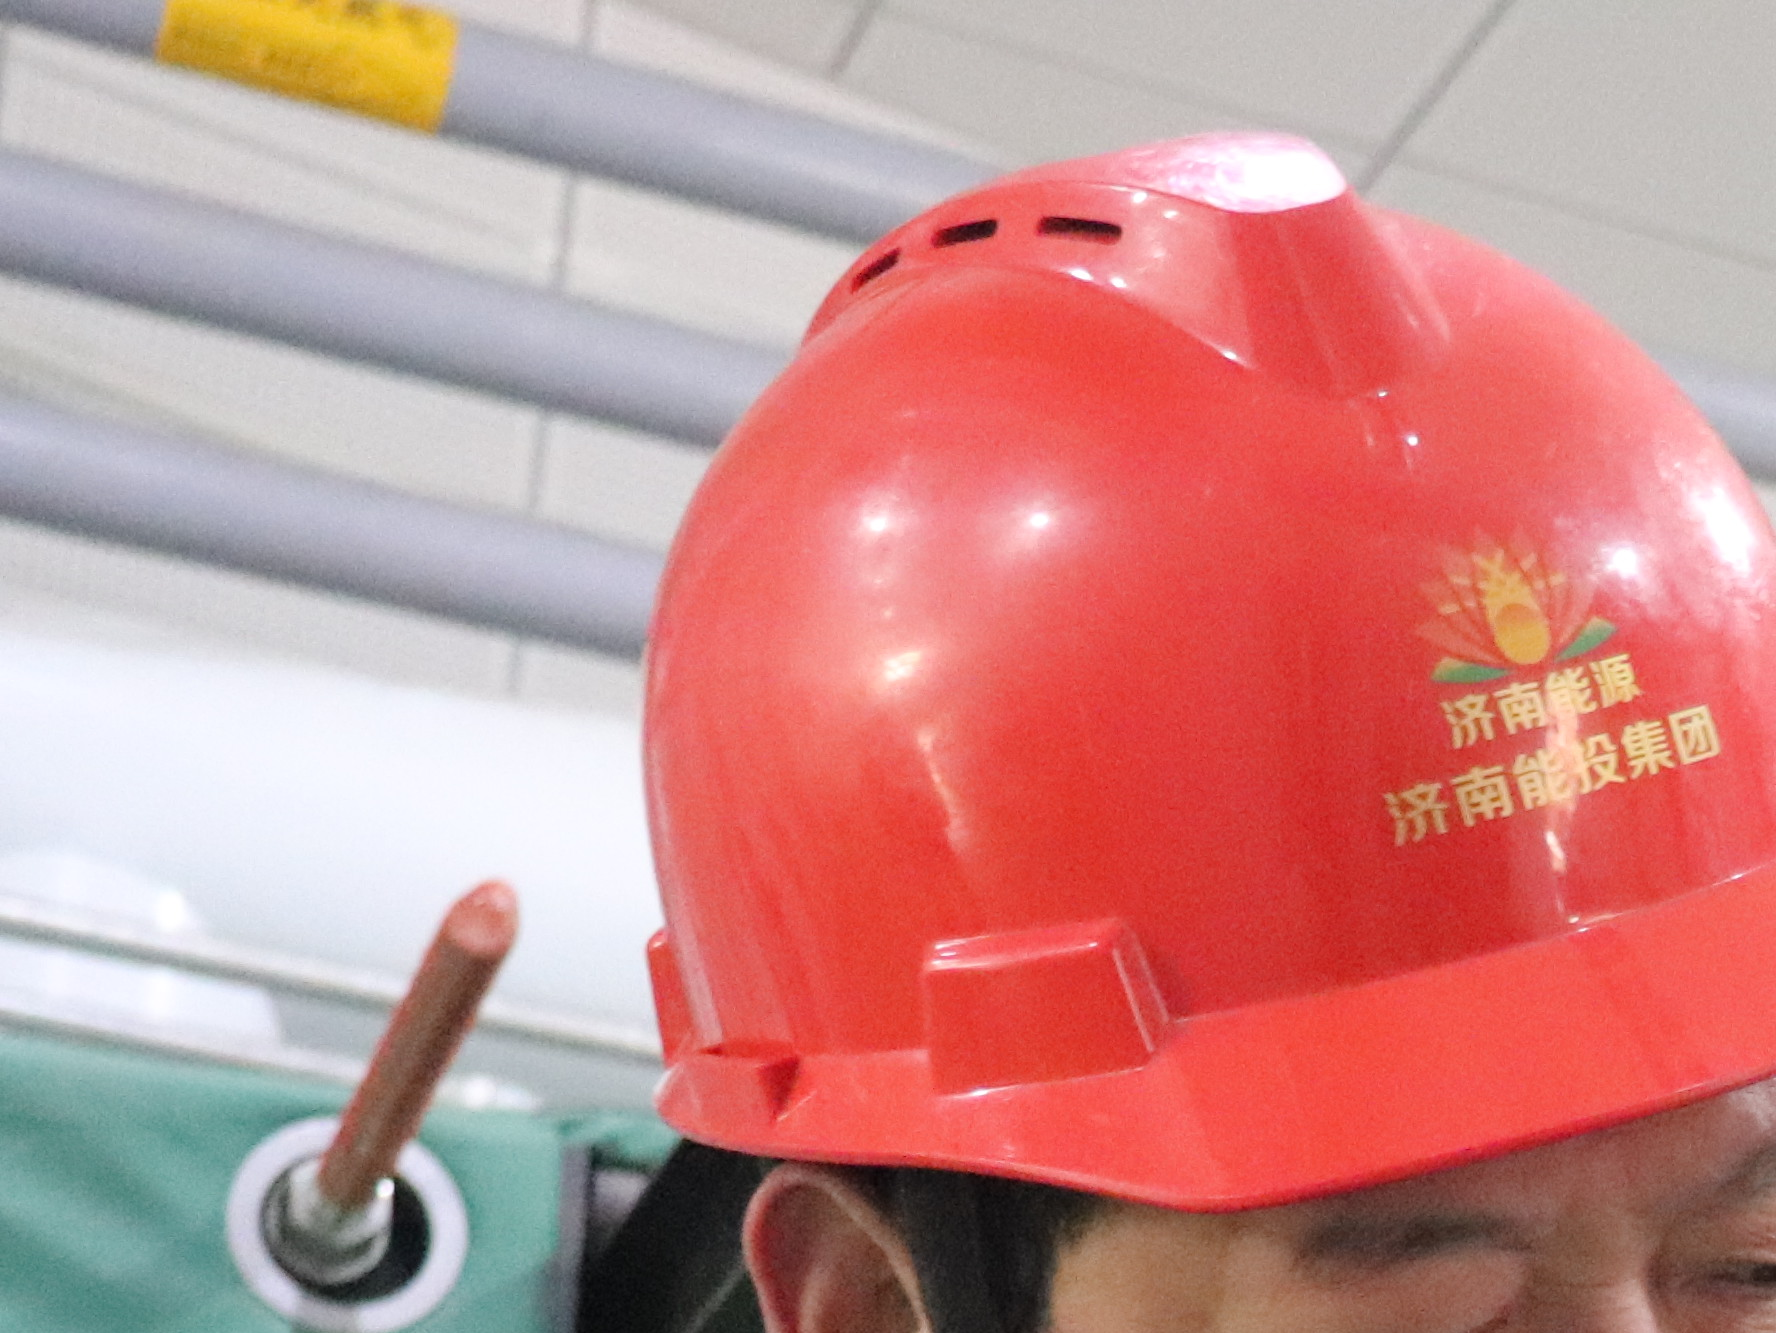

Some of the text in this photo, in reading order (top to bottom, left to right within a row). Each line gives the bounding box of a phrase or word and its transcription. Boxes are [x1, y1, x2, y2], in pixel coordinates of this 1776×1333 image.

[1440, 653, 1641, 749] 济南能源
[1384, 703, 1721, 847] 济南能投集团
